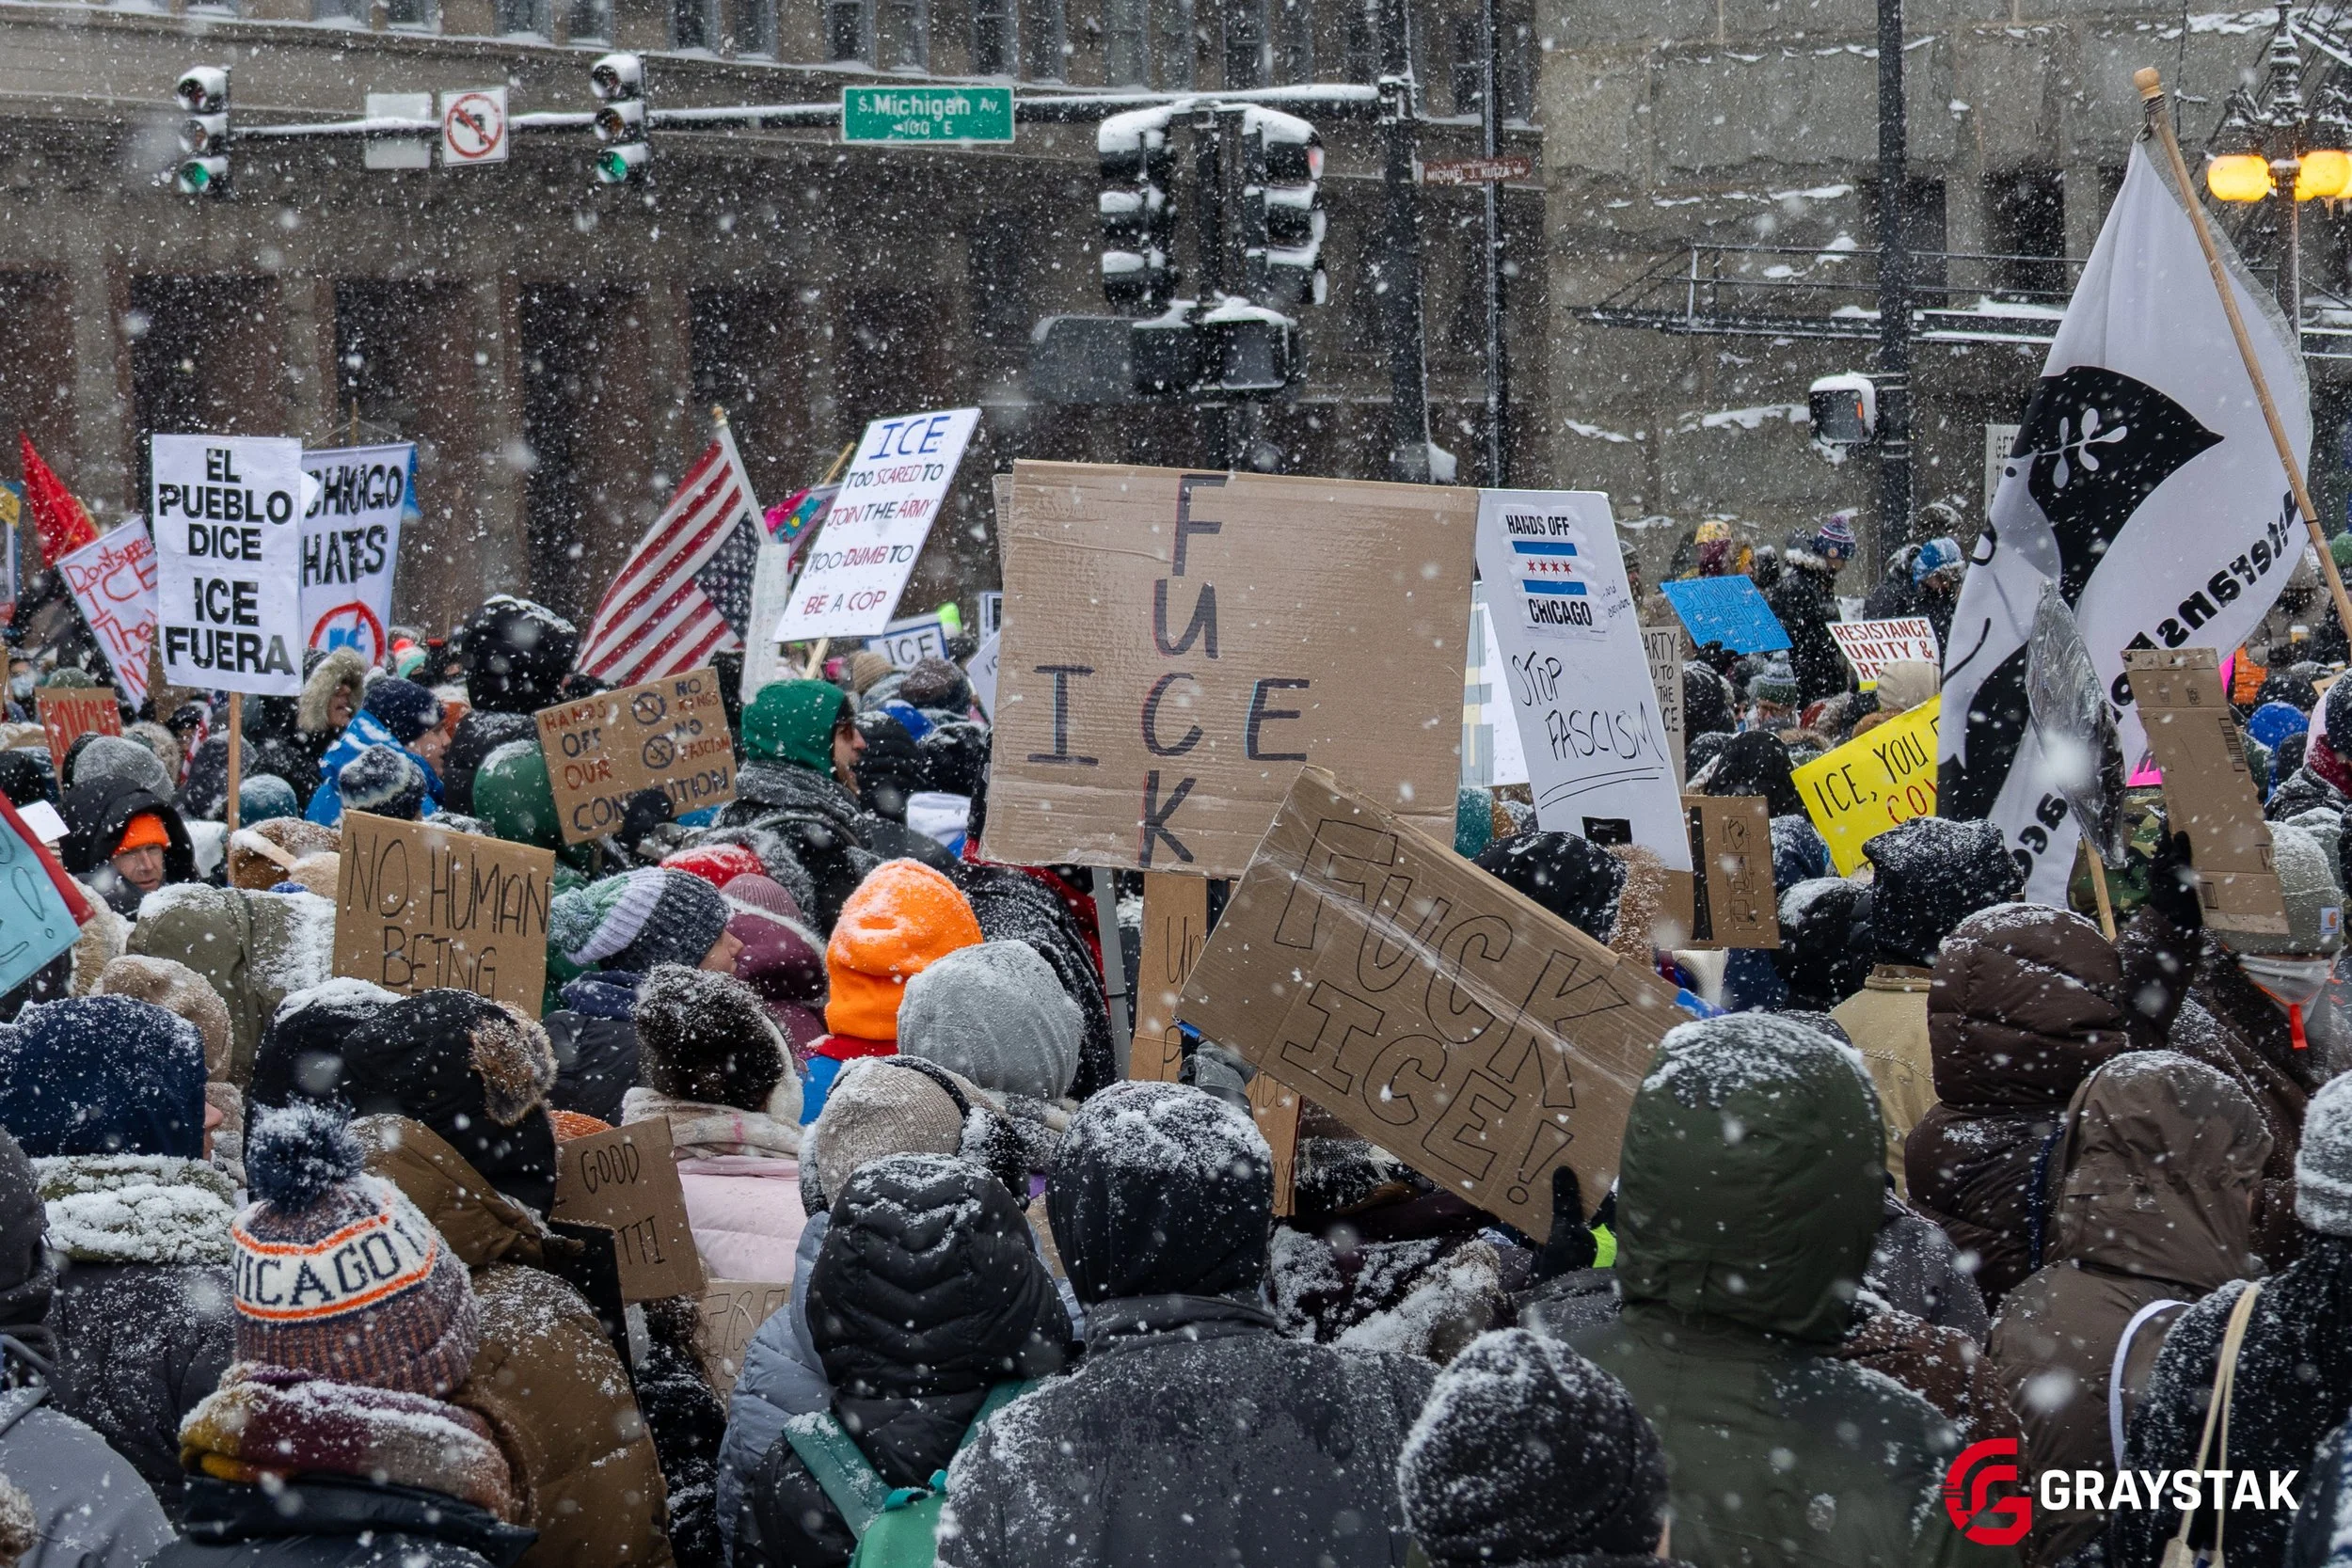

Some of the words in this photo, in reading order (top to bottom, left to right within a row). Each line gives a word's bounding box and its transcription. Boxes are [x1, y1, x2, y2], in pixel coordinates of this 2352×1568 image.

[873, 93, 971, 121] Michigan
[945, 120, 954, 135] E
[869, 416, 951, 460] ICE
[206, 448, 242, 483] EL
[847, 469, 873, 489] TOO
[872, 465, 922, 486] SCARED
[922, 464, 945, 483] TO
[159, 483, 294, 525] PUEBLO
[828, 505, 866, 527] JOIN
[866, 500, 898, 522] THE
[896, 499, 933, 519] ARMY
[188, 523, 262, 562] DICE
[1506, 515, 1546, 535] HANDS
[1549, 516, 1570, 536] OFF
[303, 525, 389, 588] HATES
[809, 551, 843, 572] TOO
[843, 546, 889, 567] DUMB
[889, 545, 914, 563] TO
[194, 578, 260, 627] ICE
[803, 594, 829, 615] BE
[830, 594, 844, 612] A
[847, 591, 887, 611] COP
[1528, 598, 1593, 626] CHICAGO
[1641, 631, 1676, 661] ARTY
[1832, 620, 1932, 641] RESISTANCE
[166, 626, 296, 676] FUERA
[883, 632, 934, 666] ICE
[1845, 641, 1912, 659] UNITY
[1919, 640, 1935, 659] &
[675, 678, 702, 696] NO
[1138, 473, 1227, 869] FUCK
[1512, 650, 1563, 706] STOP
[1660, 664, 1674, 681] TO
[1658, 685, 1675, 703] THE
[543, 700, 607, 734] HANDS
[1026, 664, 1311, 767] ICE
[1545, 701, 1664, 762] FASCISM
[562, 727, 601, 758] OFF
[564, 759, 613, 791] OUR
[1813, 763, 1878, 819] ICE,
[1872, 731, 1930, 784] YOU
[347, 832, 410, 918] NO
[430, 846, 551, 937] HUMAN
[382, 925, 498, 1002] BEING
[1274, 819, 1629, 1108] FUCK
[1279, 979, 1573, 1205] ICE!
[580, 1142, 641, 1195] GOOD
